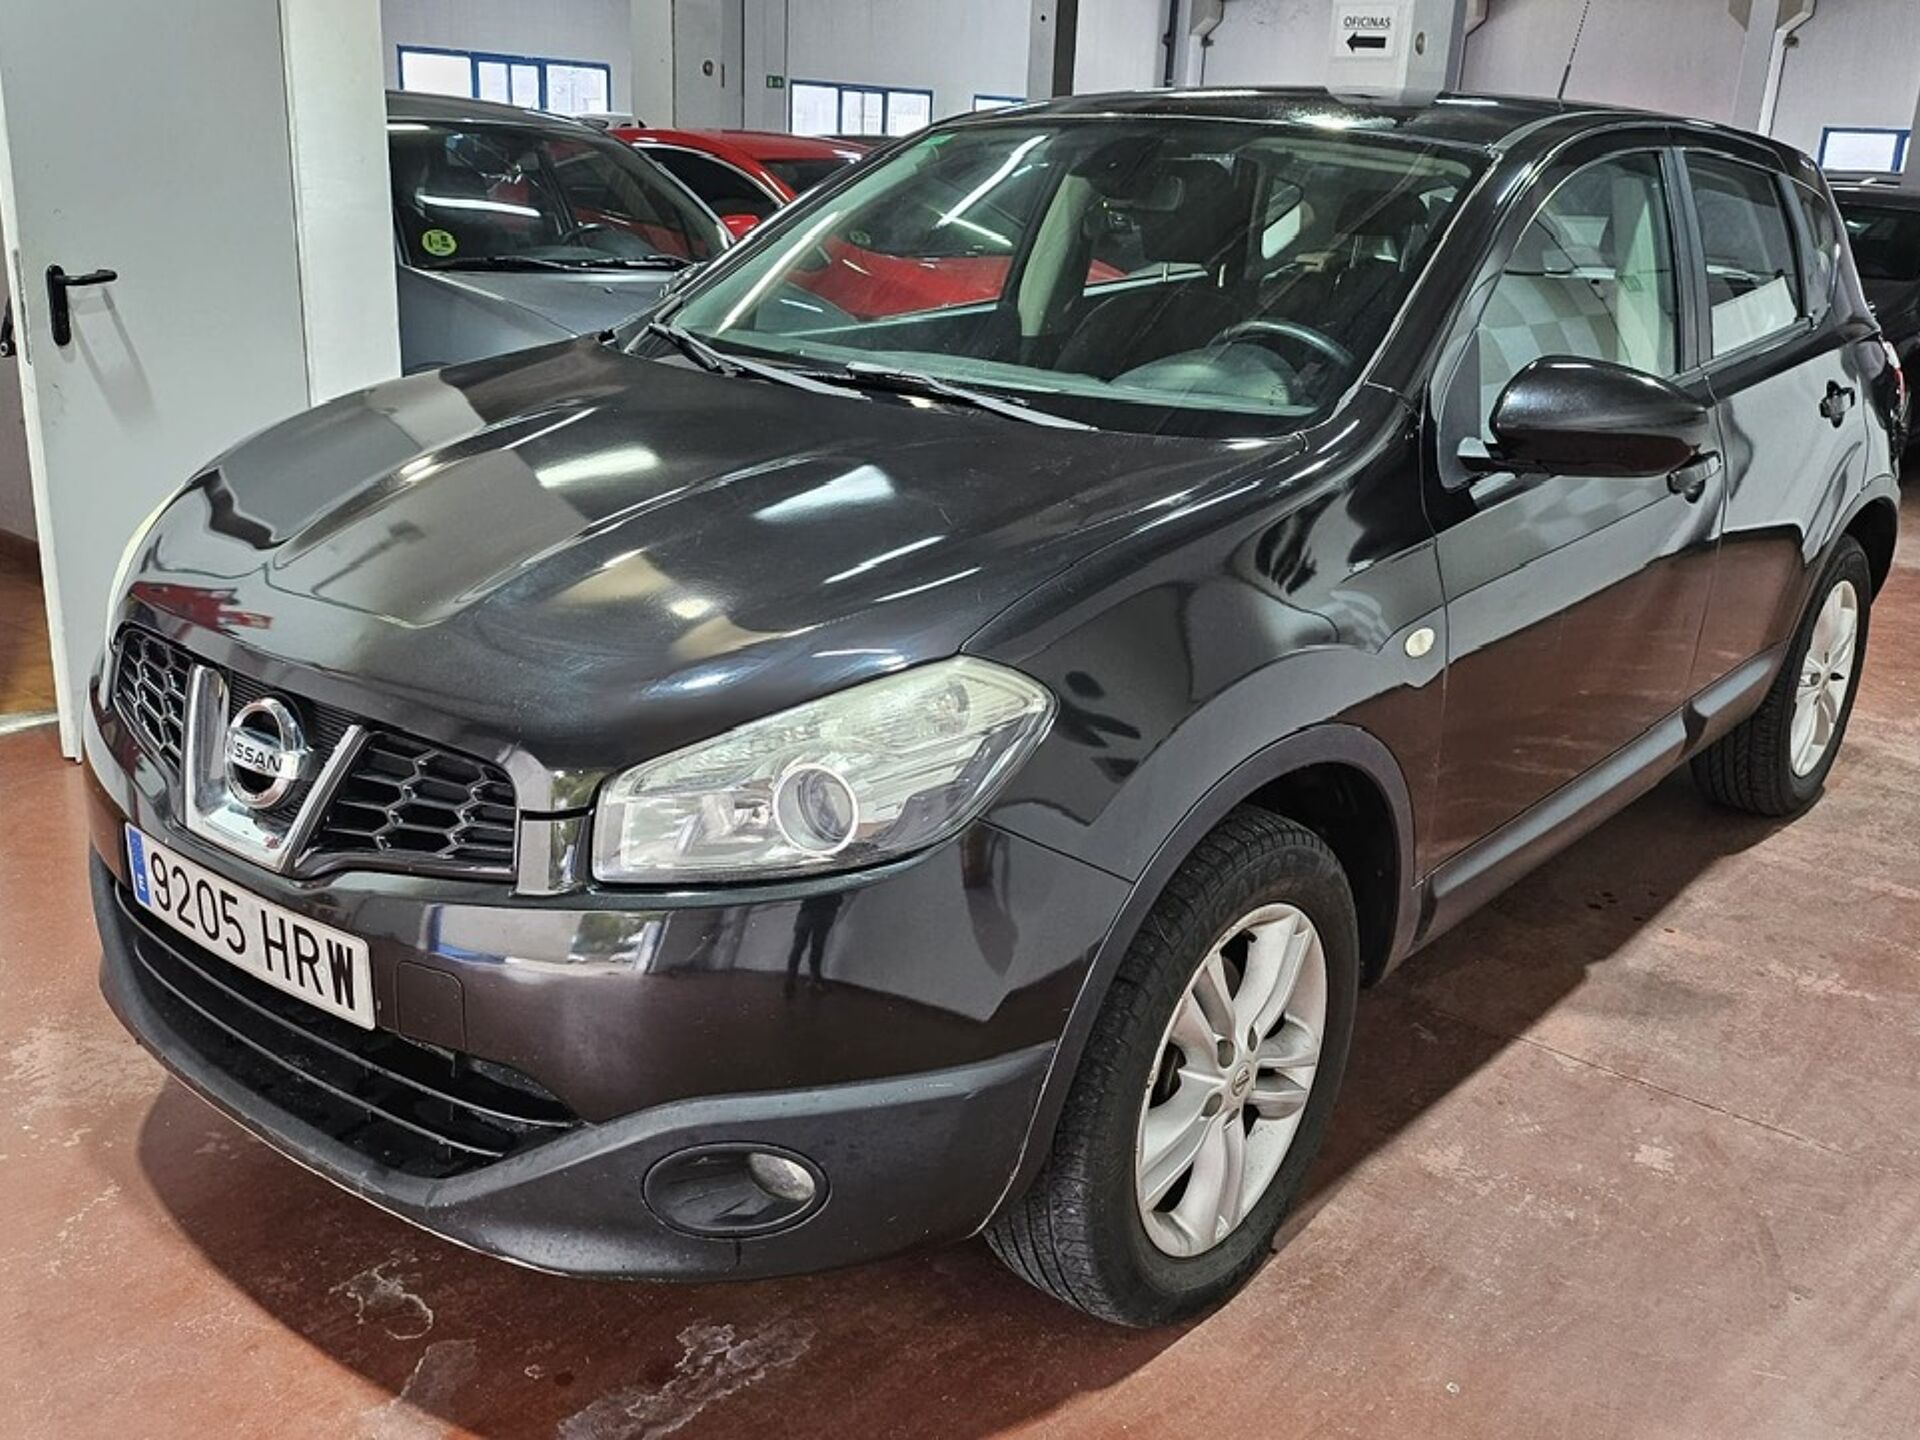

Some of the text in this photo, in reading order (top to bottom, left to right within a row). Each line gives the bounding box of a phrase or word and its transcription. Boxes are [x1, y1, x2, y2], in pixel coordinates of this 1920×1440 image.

[1343, 15, 1391, 28] OFICINAS
[227, 740, 282, 772] SSAN
[151, 852, 355, 1011] 9205 HRW
